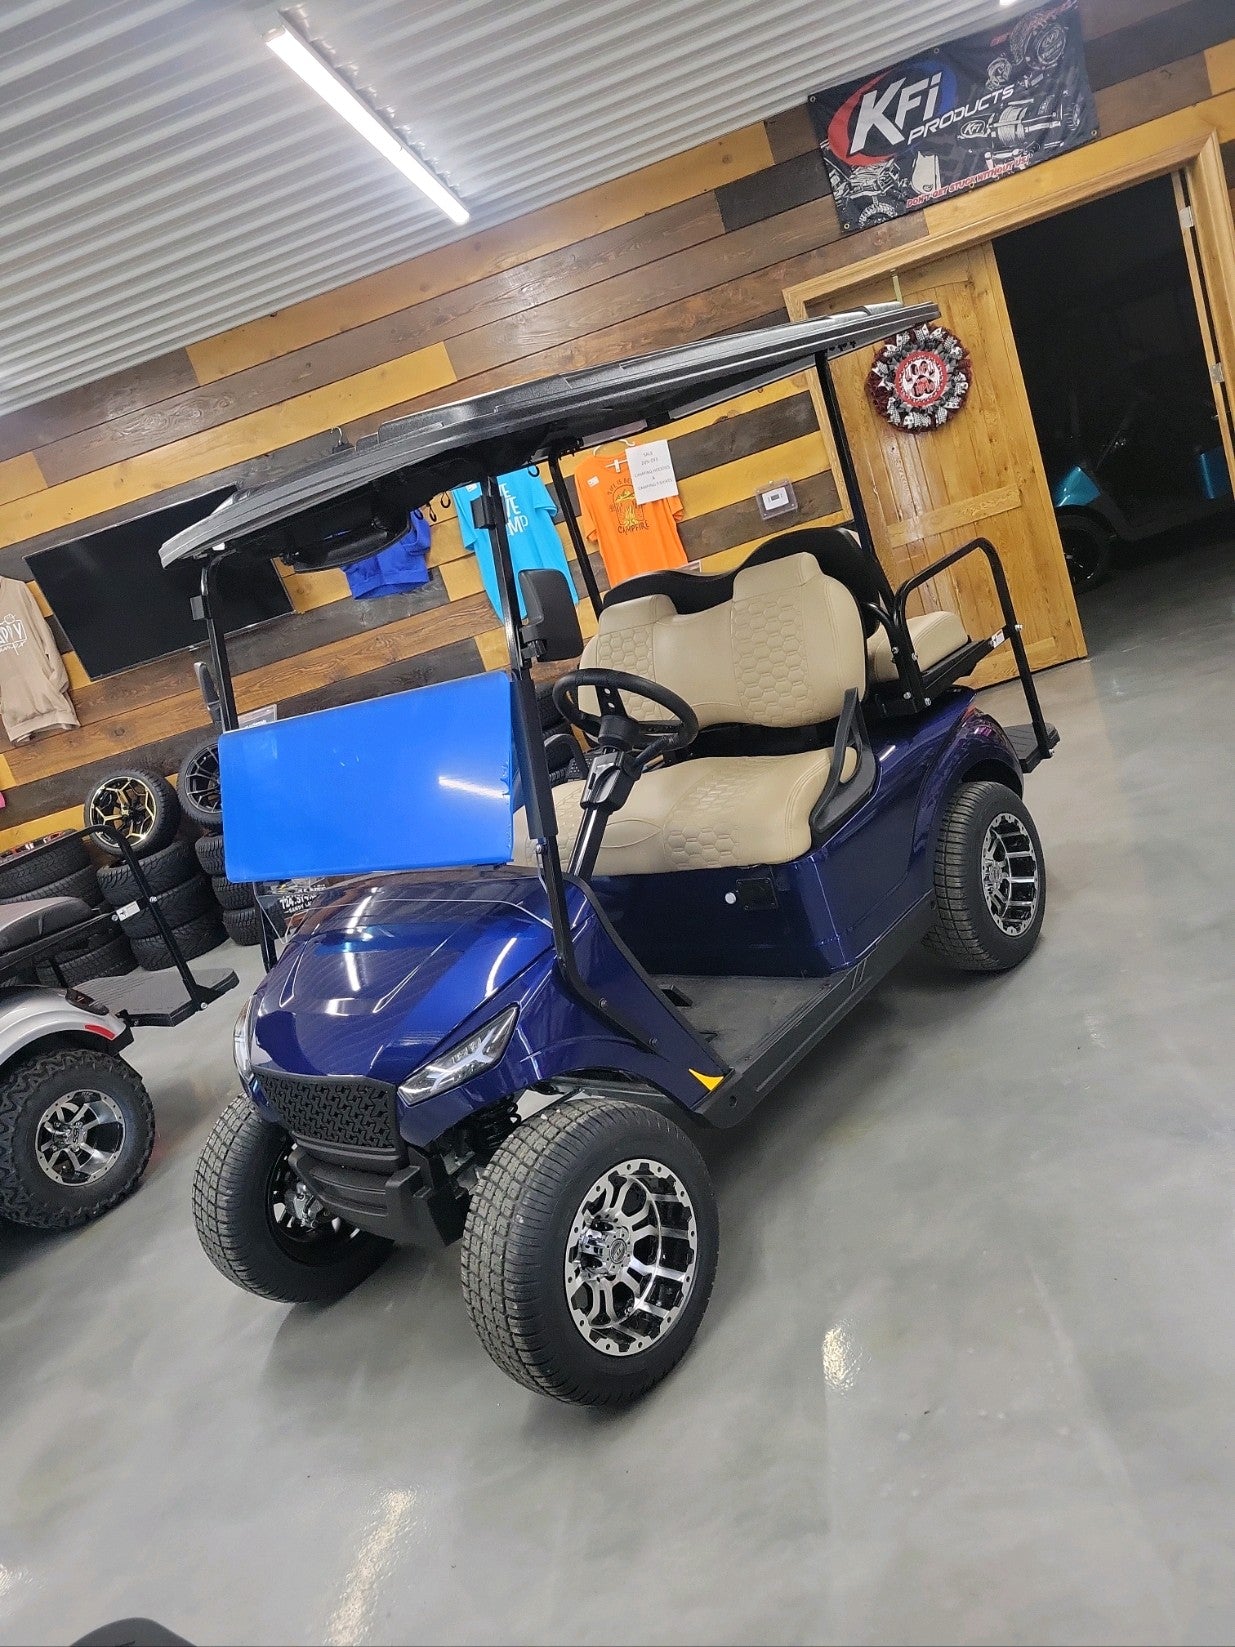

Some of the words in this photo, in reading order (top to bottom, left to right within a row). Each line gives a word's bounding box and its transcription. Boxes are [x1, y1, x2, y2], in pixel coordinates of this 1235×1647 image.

[907, 84, 1014, 145] PRODUCTS
[906, 193, 931, 208] DON'T
[932, 186, 949, 199] GET
[976, 164, 1015, 182] WITHOUT
[618, 520, 650, 535] CAMPFIRE
